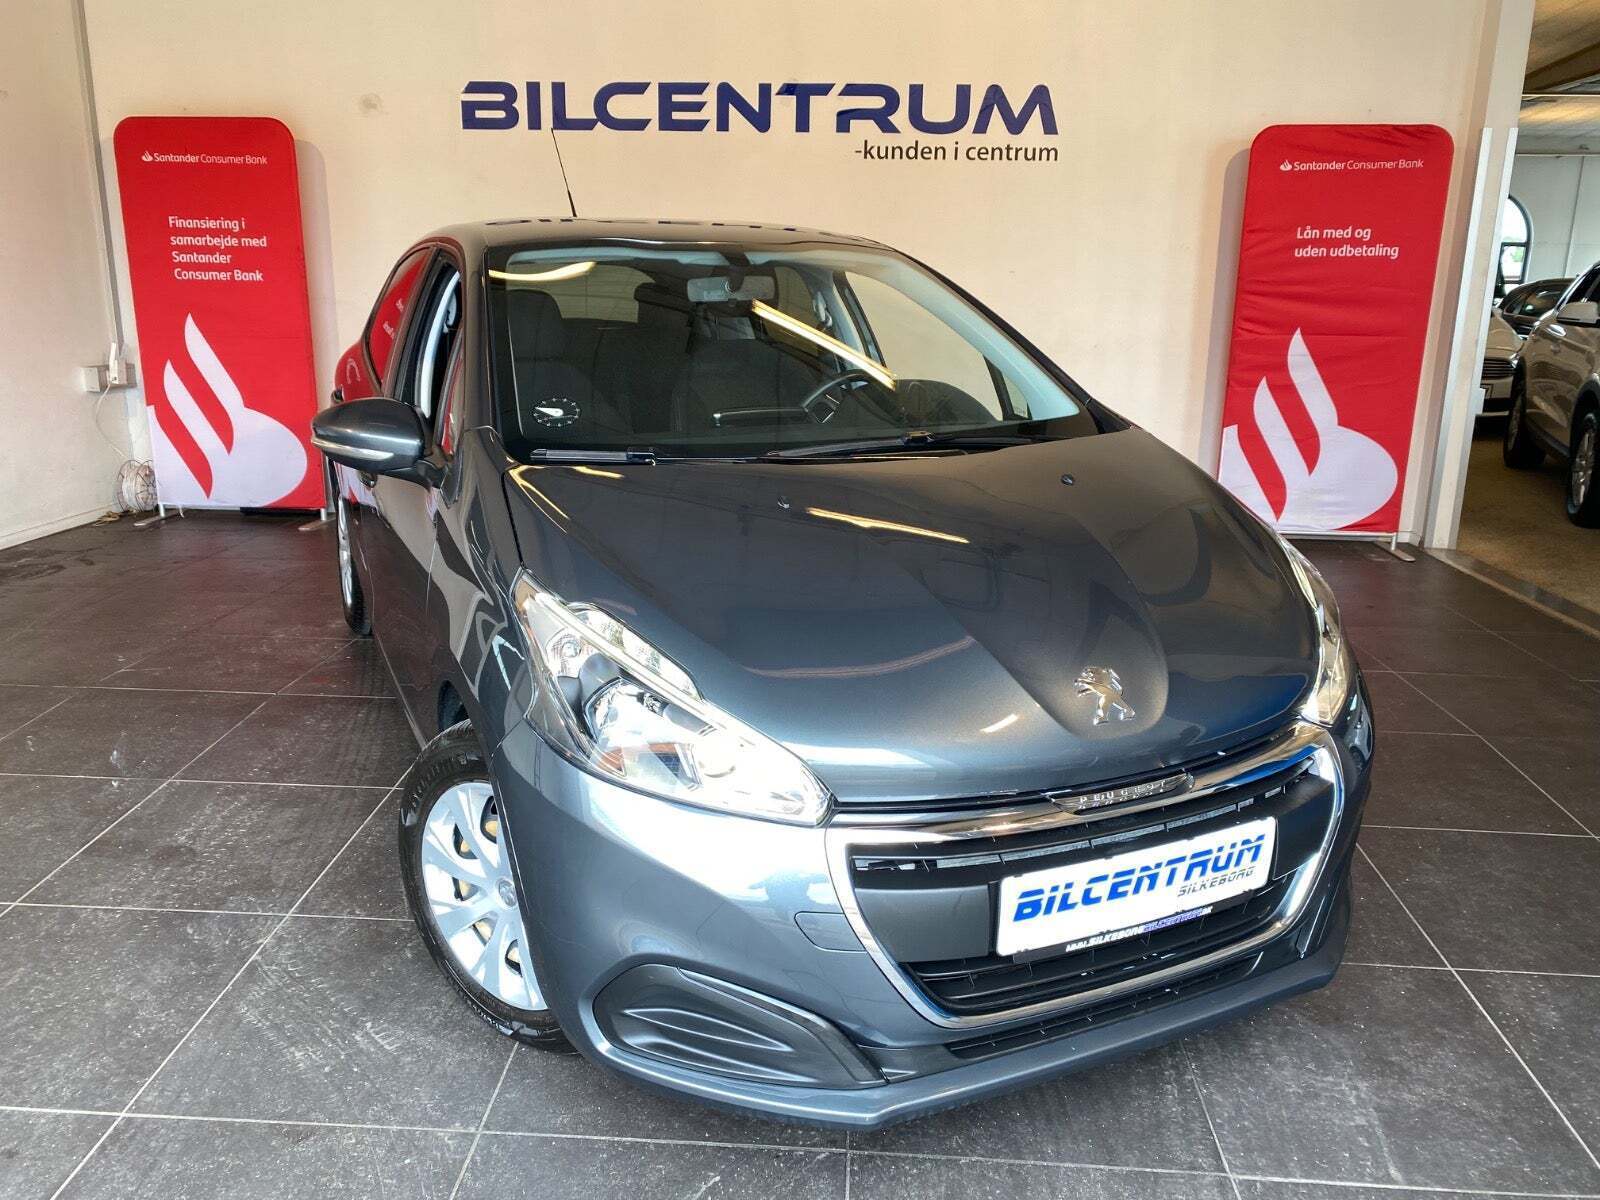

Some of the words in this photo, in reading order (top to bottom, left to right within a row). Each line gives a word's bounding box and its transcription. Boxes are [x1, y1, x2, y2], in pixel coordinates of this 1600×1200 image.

[461, 81, 1058, 136] BILCENTRUM
[154, 153, 200, 163] Santander
[200, 154, 246, 164] Consumer
[246, 156, 268, 165] Bank
[855, 141, 947, 161] -kunden
[953, 142, 959, 161] i
[966, 144, 1059, 162] centrum
[1293, 161, 1346, 171] Santander
[1346, 160, 1397, 170] Consumer
[1398, 159, 1424, 169] Bank
[168, 215, 239, 232] Finansiering
[241, 217, 246, 229] i
[1296, 226, 1320, 239] Lån
[1322, 226, 1352, 239] med
[1354, 228, 1372, 241] og
[170, 234, 239, 249] samarbejde
[241, 236, 267, 247] med
[171, 251, 232, 264] Santander
[1294, 245, 1327, 258] uden
[1329, 244, 1400, 260] udbetaling
[174, 268, 232, 281] Consumer
[234, 269, 264, 282] Bank
[1013, 833, 1266, 922] BILCENTRUM
[1177, 865, 1257, 898] SILKEBORG
